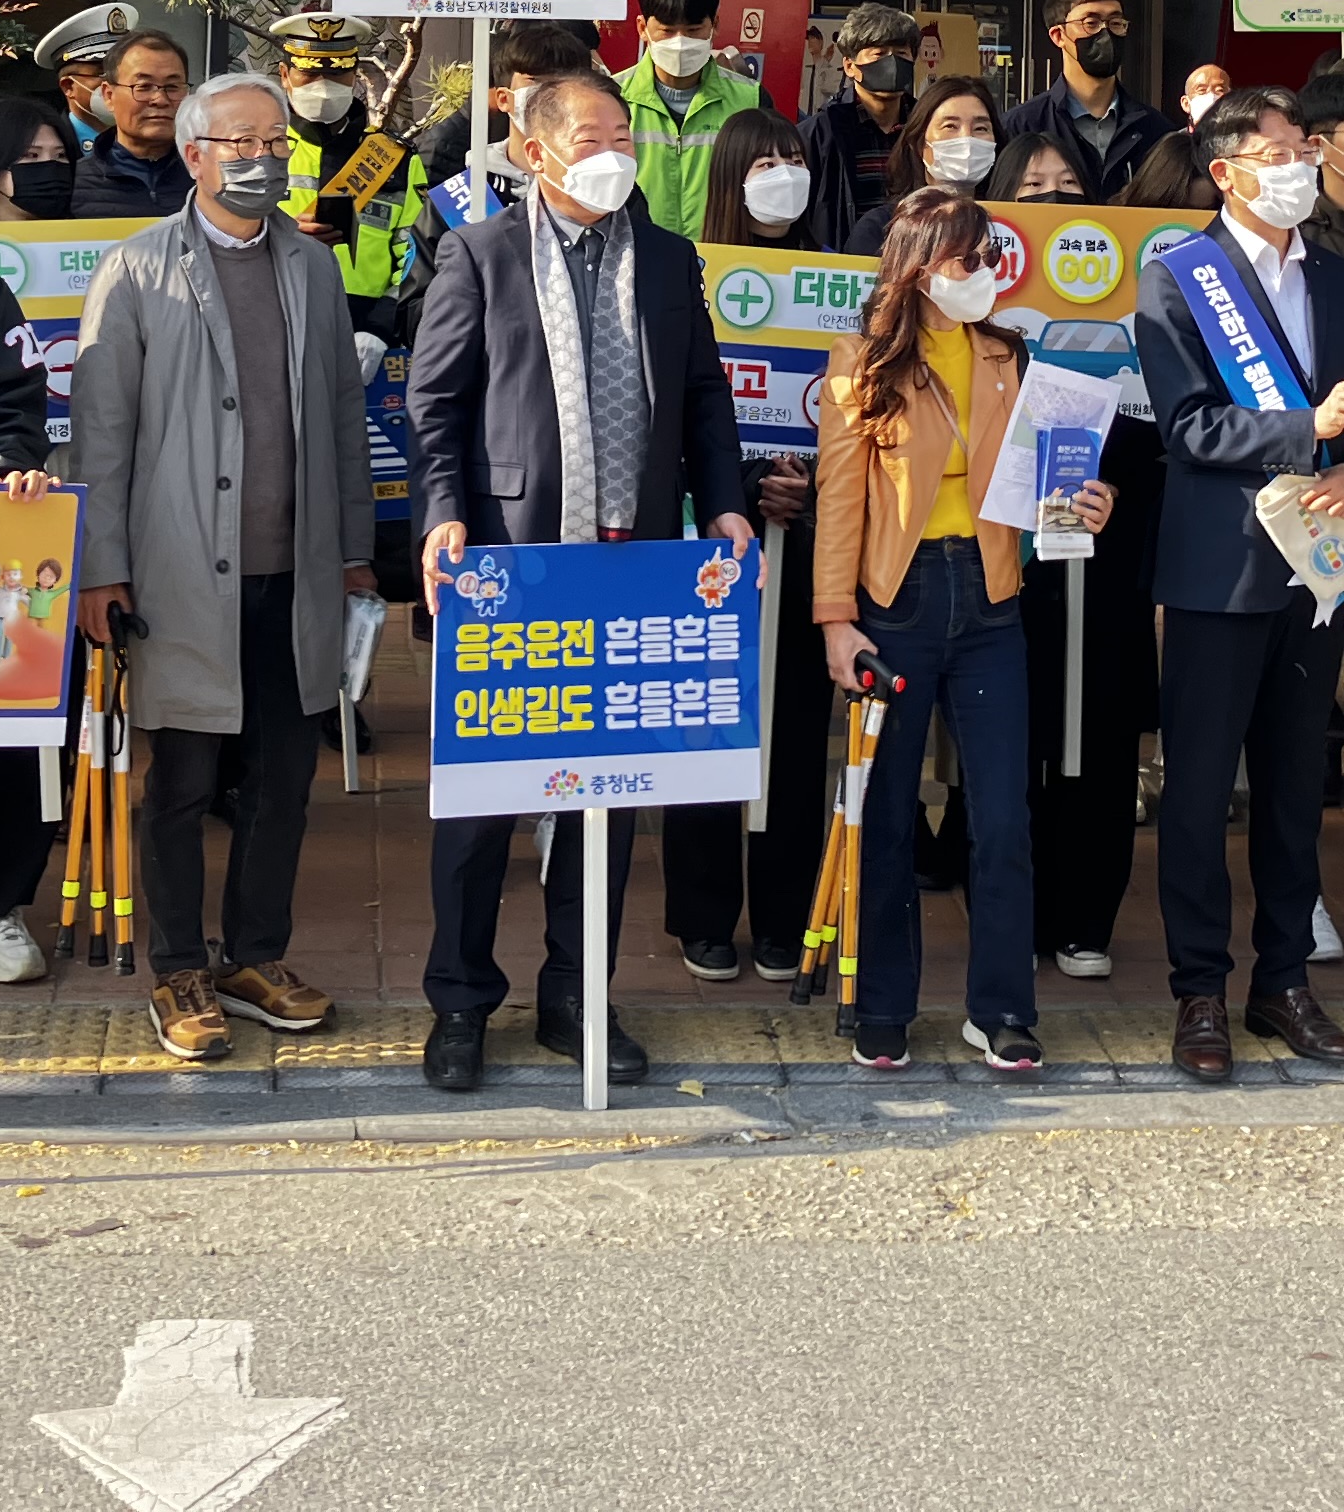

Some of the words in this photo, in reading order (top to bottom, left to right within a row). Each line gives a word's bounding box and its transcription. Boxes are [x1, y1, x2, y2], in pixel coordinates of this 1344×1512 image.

[434, 0, 552, 15] 충청남도자치경찰위원회
[1059, 239, 1083, 251] 과속
[1085, 240, 1108, 252] 멈추
[1056, 254, 1111, 285] GO!
[794, 271, 879, 309] 더하
[1192, 263, 1261, 364] 안전하고
[5, 322, 48, 371] 2
[383, 354, 413, 383] 멈
[1117, 402, 1154, 417] 위원회
[455, 618, 595, 672] 음주운전
[604, 613, 741, 666] 흔들흔들
[454, 685, 595, 738] 인생길도
[604, 677, 741, 731] 흔들흔들
[590, 772, 654, 795] 충청남도
